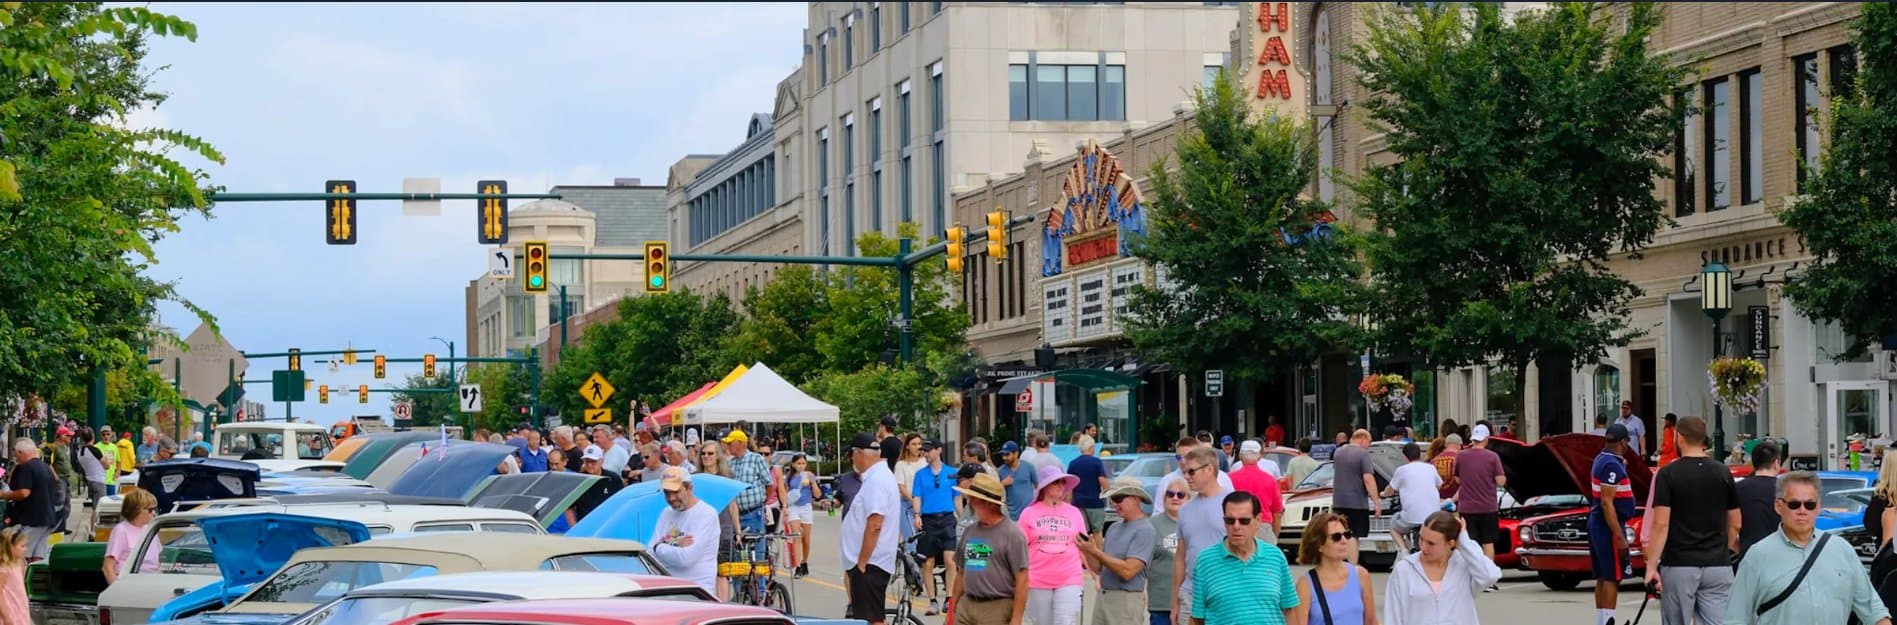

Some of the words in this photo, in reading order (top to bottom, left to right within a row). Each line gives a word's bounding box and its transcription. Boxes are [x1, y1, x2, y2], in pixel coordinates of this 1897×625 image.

[1701, 238, 1785, 268] SUNDANCE
[1754, 309, 1763, 350] SUNDANCE
[1608, 471, 1617, 483] 3
